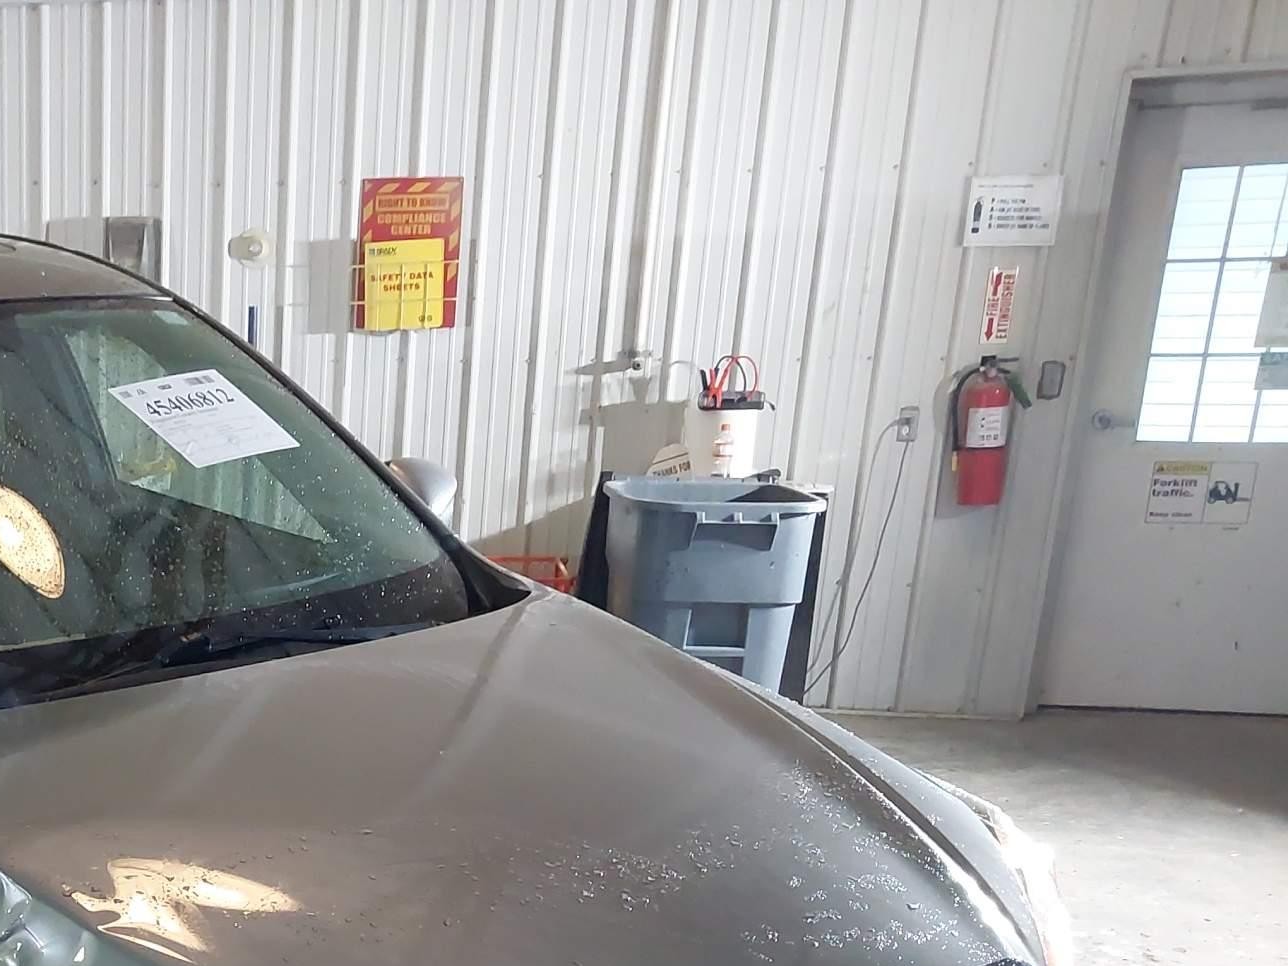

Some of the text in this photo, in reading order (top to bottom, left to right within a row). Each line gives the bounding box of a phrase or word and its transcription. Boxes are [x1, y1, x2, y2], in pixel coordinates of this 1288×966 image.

[377, 212, 447, 224] COMPLIANCE
[391, 223, 431, 236] CENTER
[370, 271, 434, 283] SFET DATA
[383, 283, 420, 293] SHEETS
[986, 297, 1000, 317] FIRE
[145, 388, 235, 417] 45406812
[1154, 478, 1198, 487] Forklift
[1152, 488, 1194, 498] traffic.
